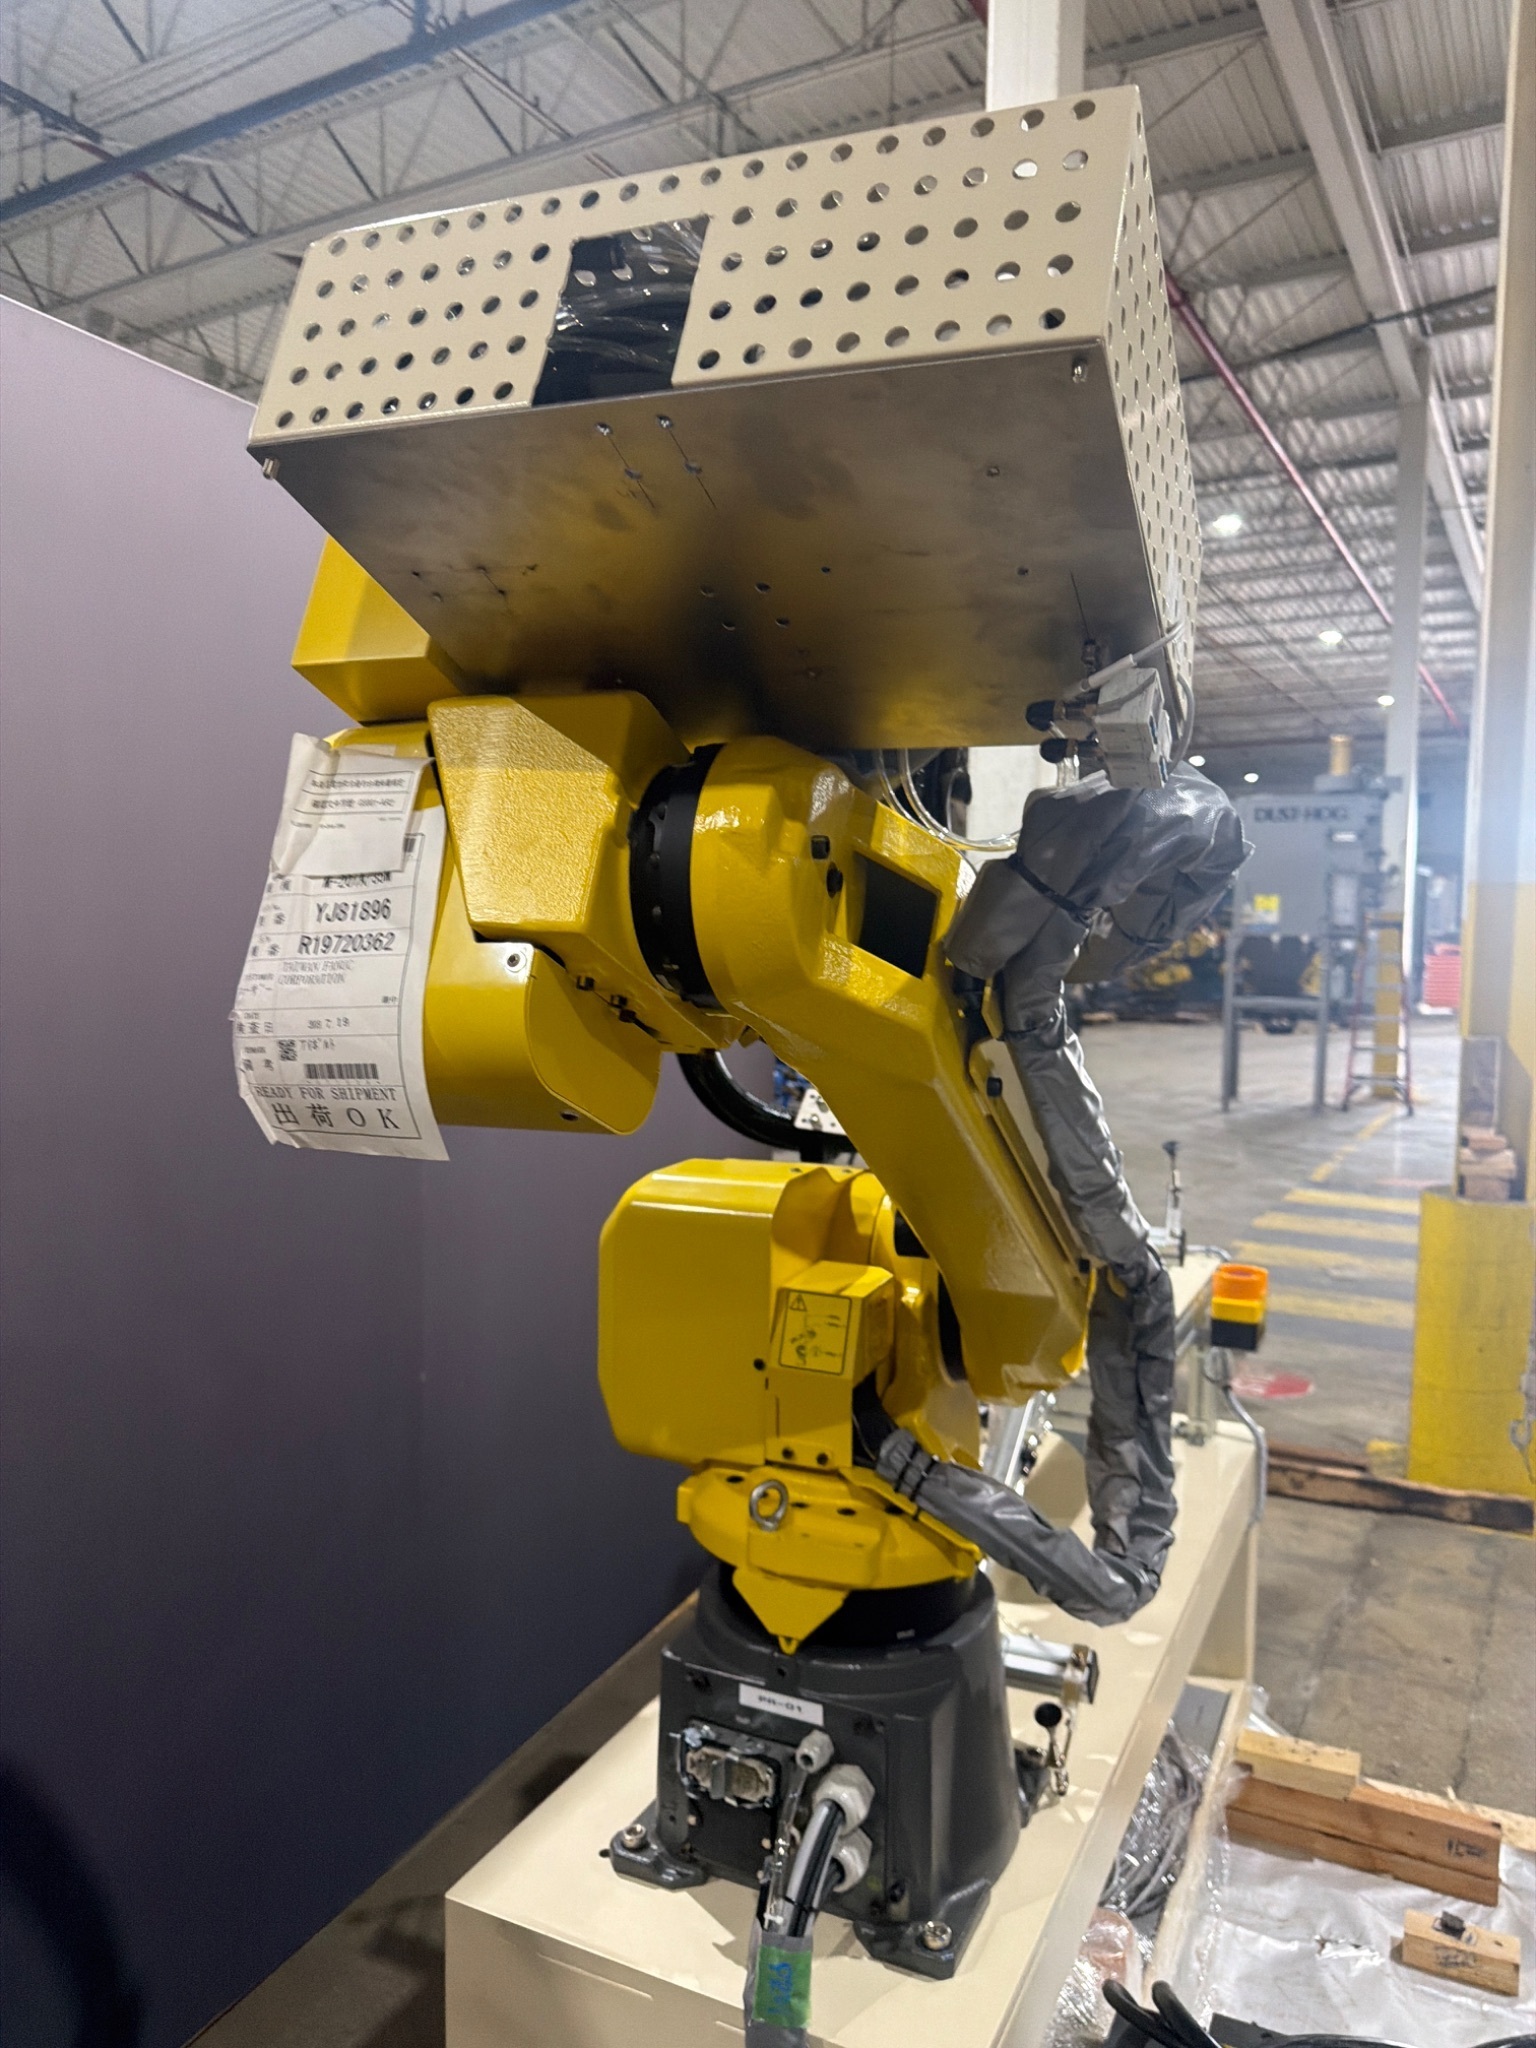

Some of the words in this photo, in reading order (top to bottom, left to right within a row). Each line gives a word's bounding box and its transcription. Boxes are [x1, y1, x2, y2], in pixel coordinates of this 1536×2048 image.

[298, 931, 396, 956] R19720362
[255, 1086, 293, 1099] READY
[302, 1086, 325, 1100] FOR
[330, 1087, 397, 1102] SHIPMENT
